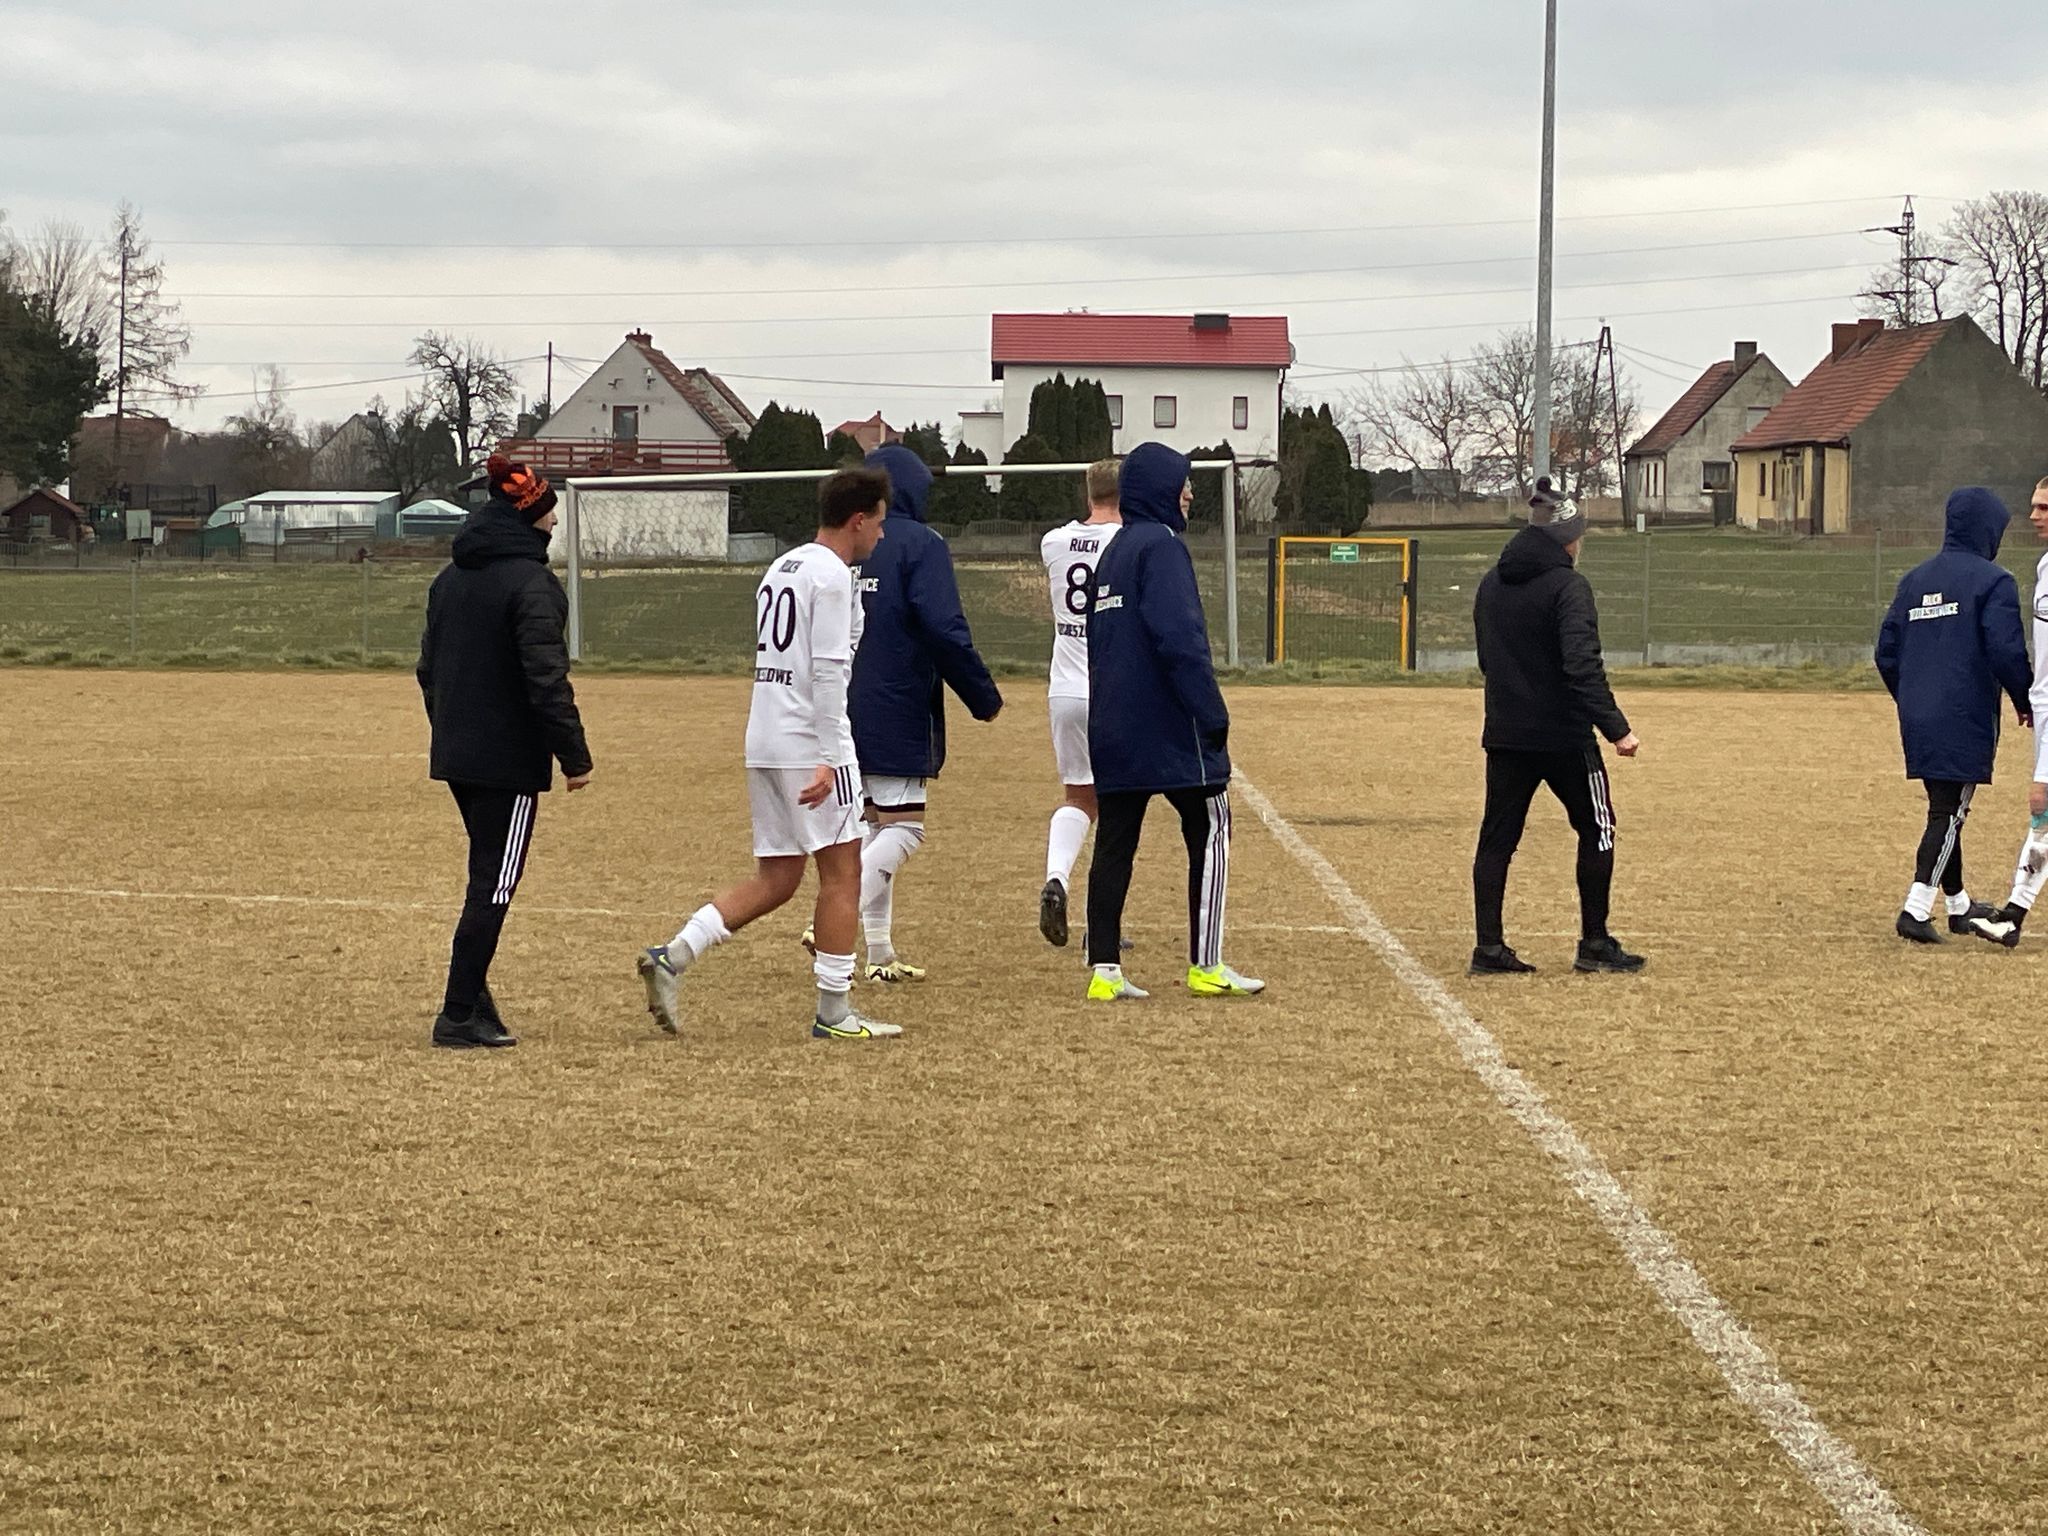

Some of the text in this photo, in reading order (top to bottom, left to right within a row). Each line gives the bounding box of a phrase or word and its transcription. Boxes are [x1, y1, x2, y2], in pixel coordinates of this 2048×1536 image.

[1069, 538, 1099, 553] RUCH
[1065, 562, 1094, 615] 8
[758, 584, 796, 653] 20
